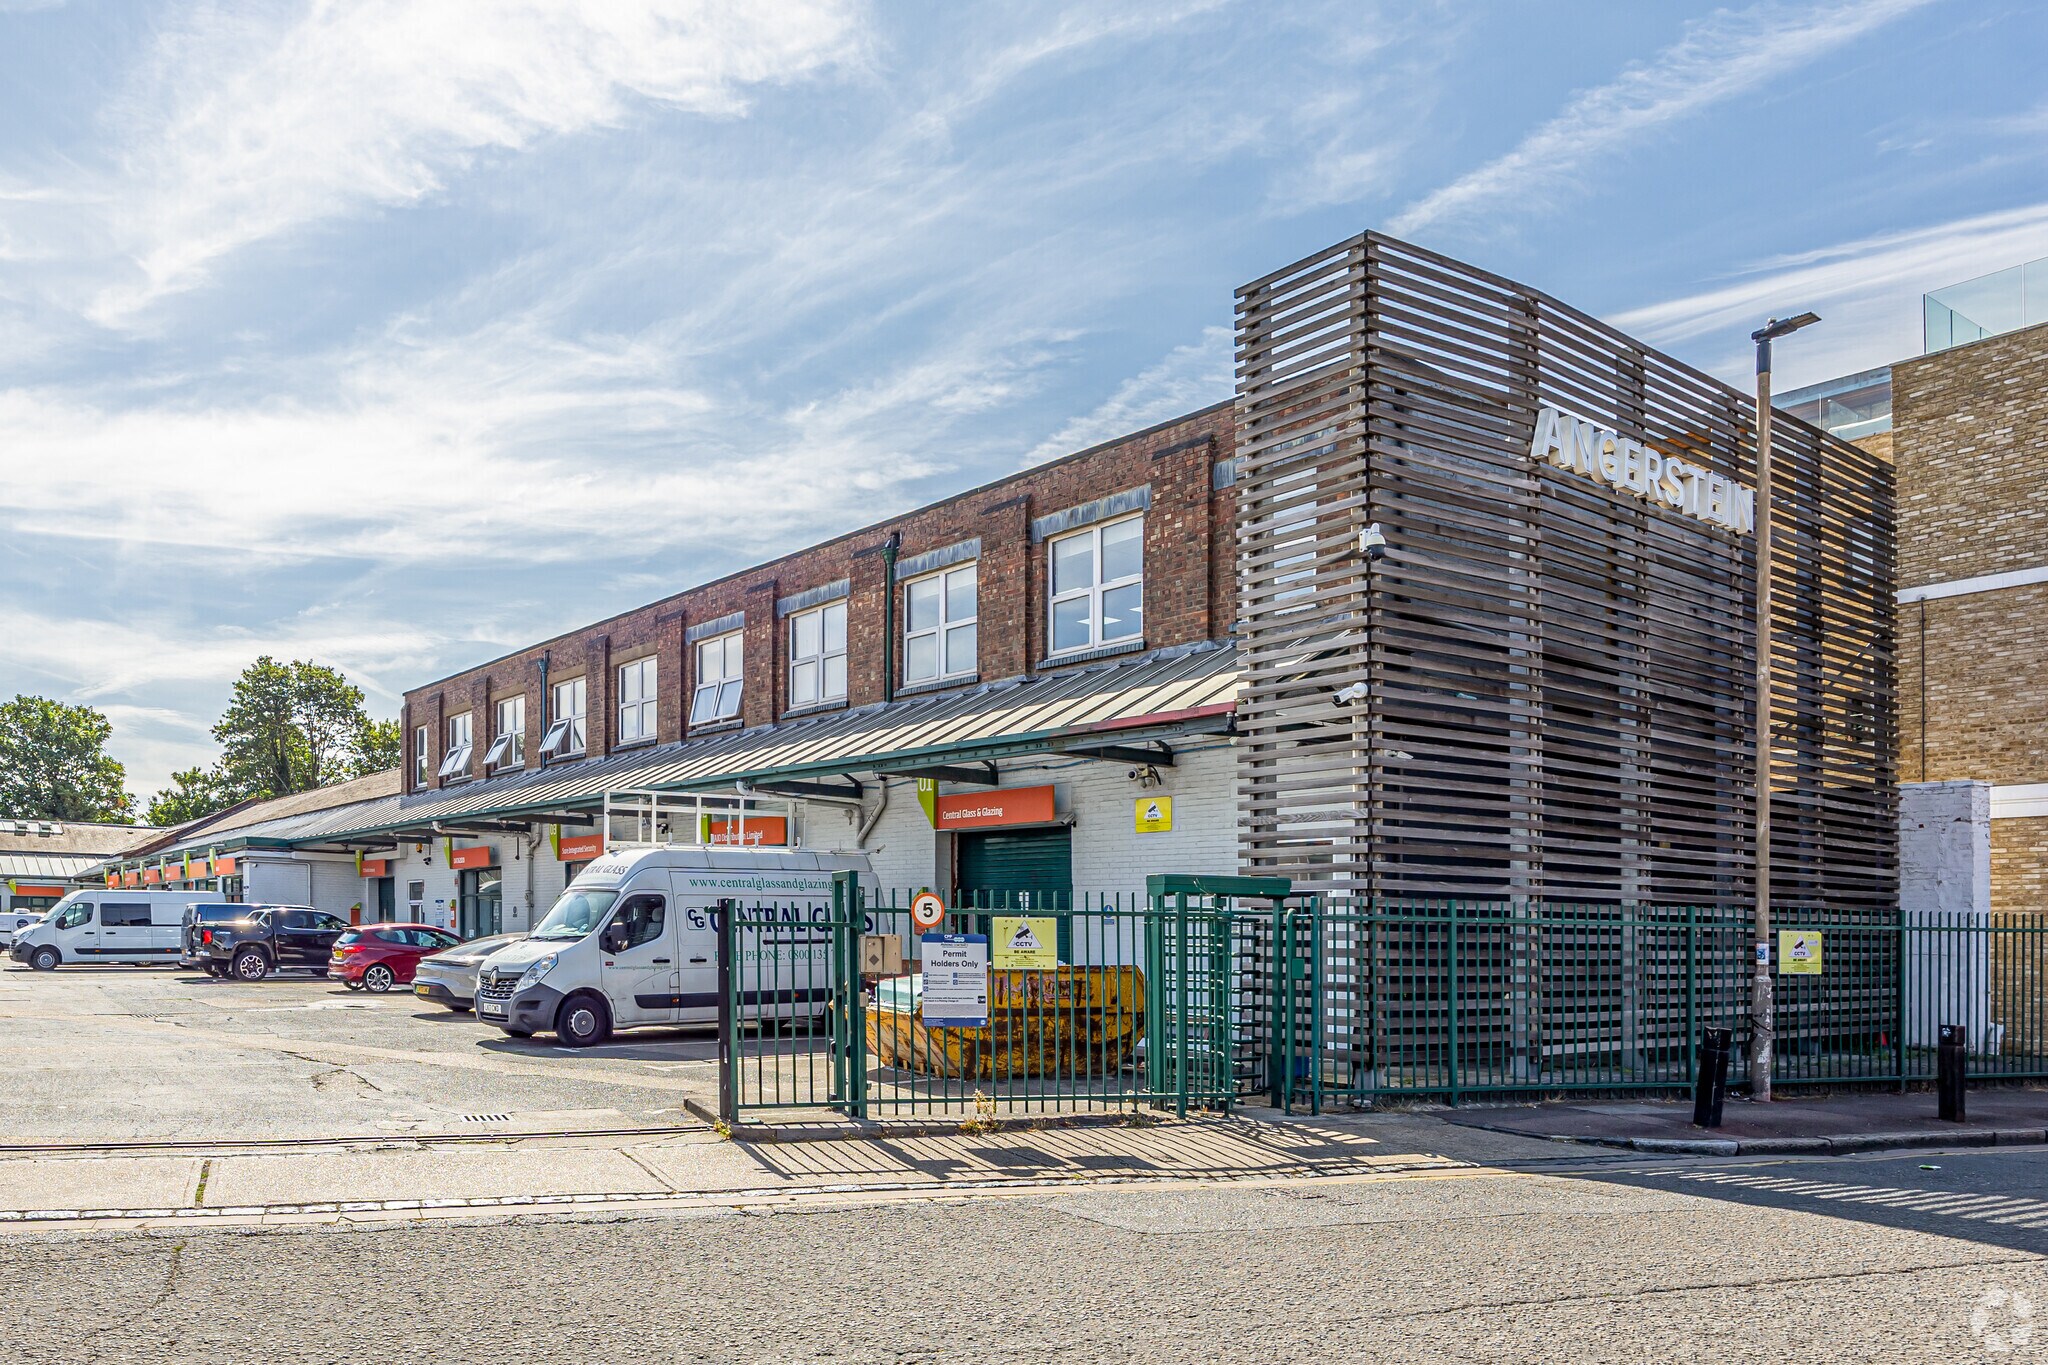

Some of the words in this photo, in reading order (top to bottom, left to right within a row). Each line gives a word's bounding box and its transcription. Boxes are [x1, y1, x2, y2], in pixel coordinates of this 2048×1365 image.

[1531, 407, 1754, 535] ANGERSTEIN
[920, 777, 932, 791] 01
[943, 810, 961, 820] Central
[962, 809, 976, 818] Glass
[976, 808, 981, 817] &
[982, 806, 1003, 817] Glazing
[603, 865, 629, 875] GLASS
[923, 902, 934, 918] 5
[709, 907, 806, 933] CNTRAL
[961, 960, 979, 969] Only
